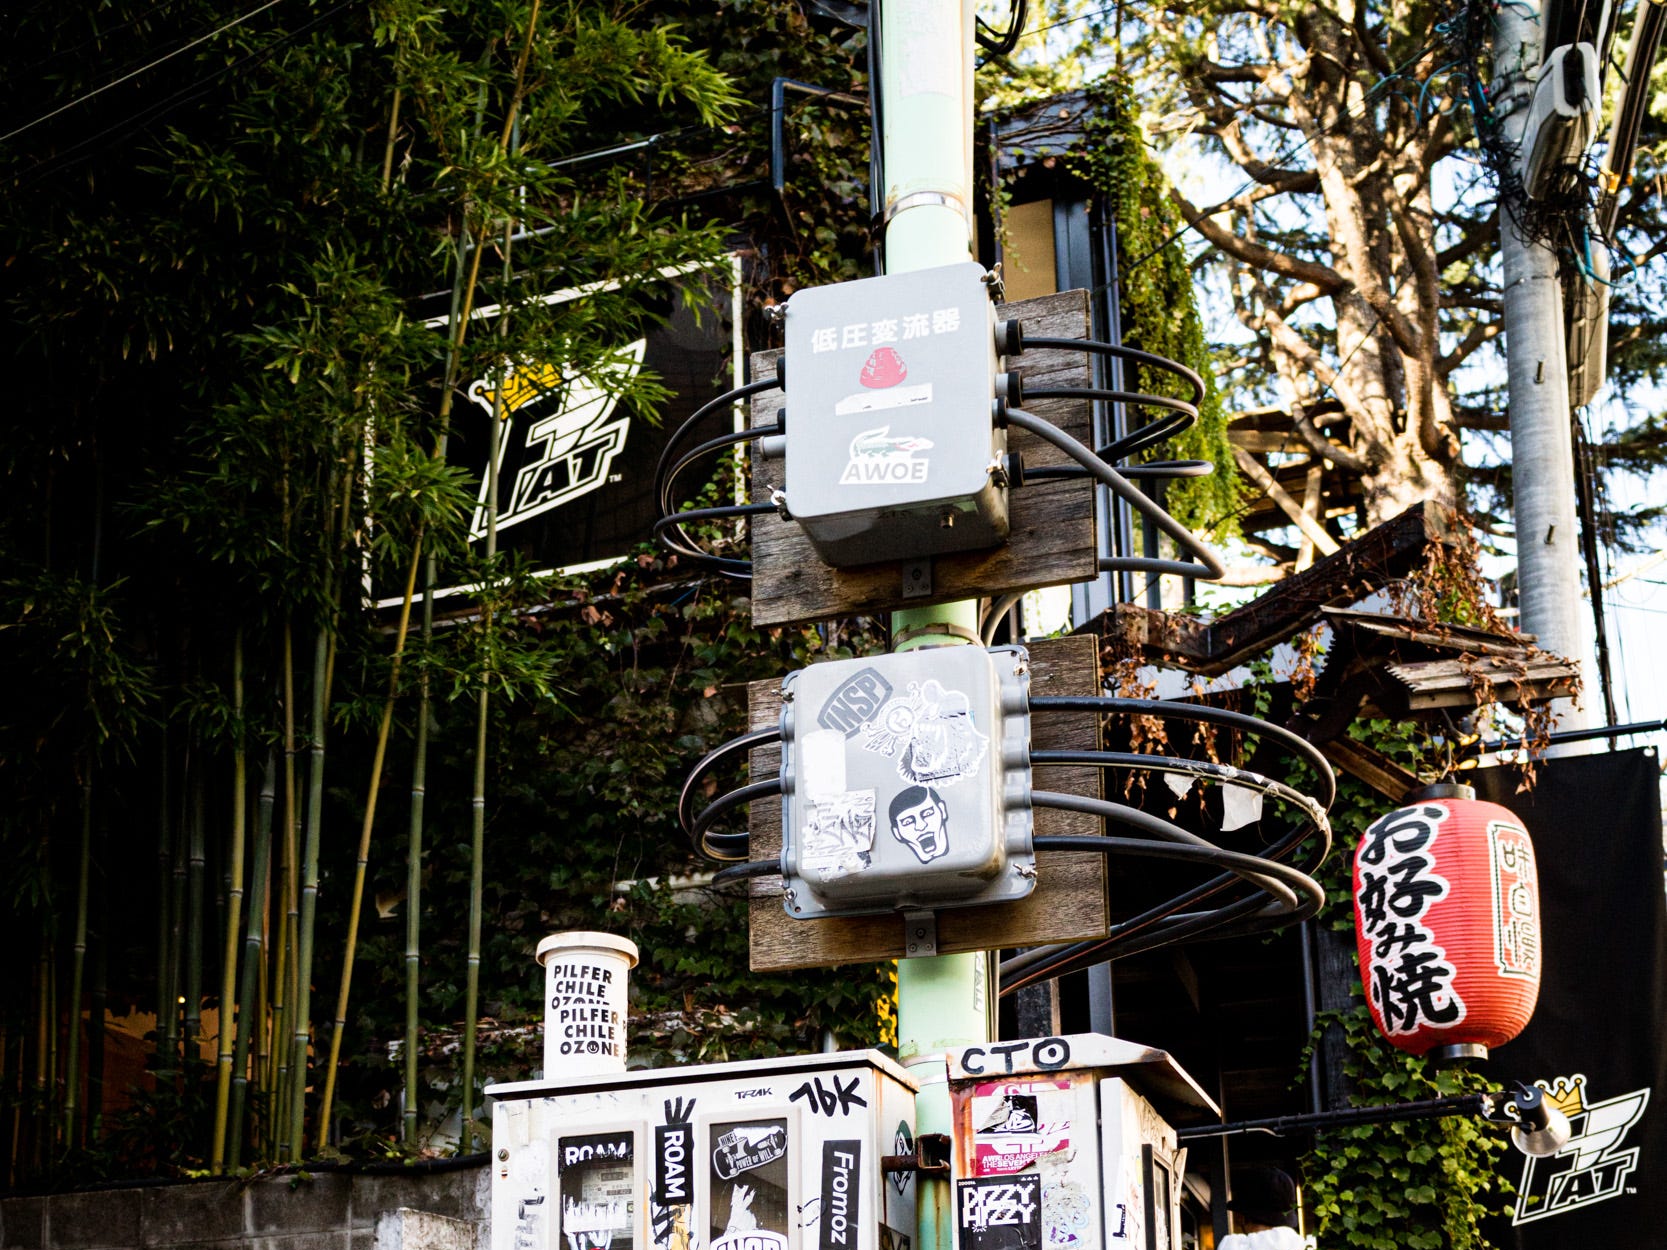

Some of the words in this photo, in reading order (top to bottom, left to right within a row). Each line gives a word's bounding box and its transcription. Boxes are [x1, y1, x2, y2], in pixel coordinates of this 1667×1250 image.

[810, 306, 961, 353] 低圧変流器
[844, 461, 925, 482] AWOE
[824, 679, 883, 735] INSP
[1360, 806, 1461, 1032] お好み焼
[554, 964, 612, 984] PILFER
[556, 980, 606, 998] CHILE
[560, 1008, 619, 1025] PILFER
[564, 1024, 615, 1040] CHILE
[560, 1040, 620, 1057] OZONE
[664, 1130, 686, 1199] ROAM
[831, 1150, 854, 1245] Fromoz
